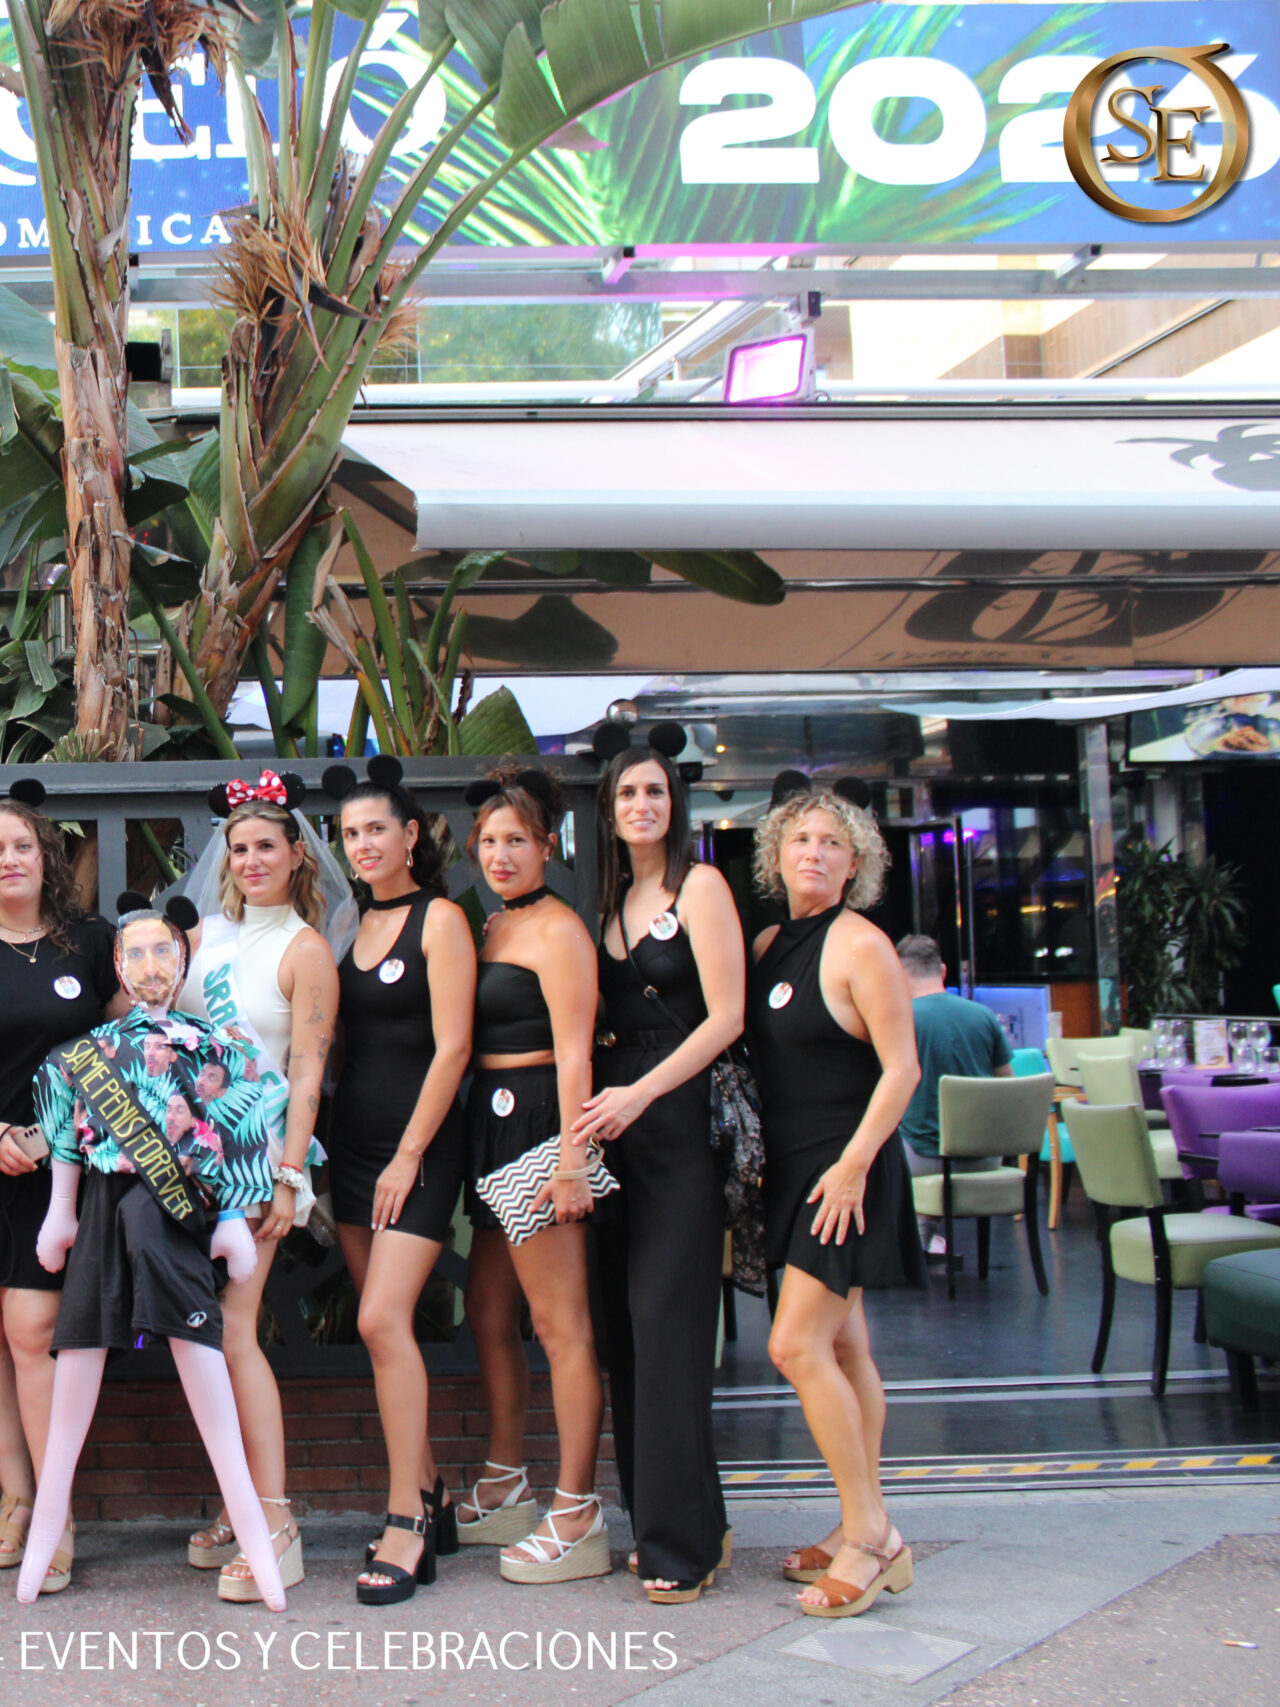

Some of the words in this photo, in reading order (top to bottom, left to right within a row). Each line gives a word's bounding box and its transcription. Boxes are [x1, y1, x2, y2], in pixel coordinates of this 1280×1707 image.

[60, 1038, 111, 1093] SAME
[90, 1077, 147, 1138] PENIS
[124, 1127, 193, 1220] FOREVER
